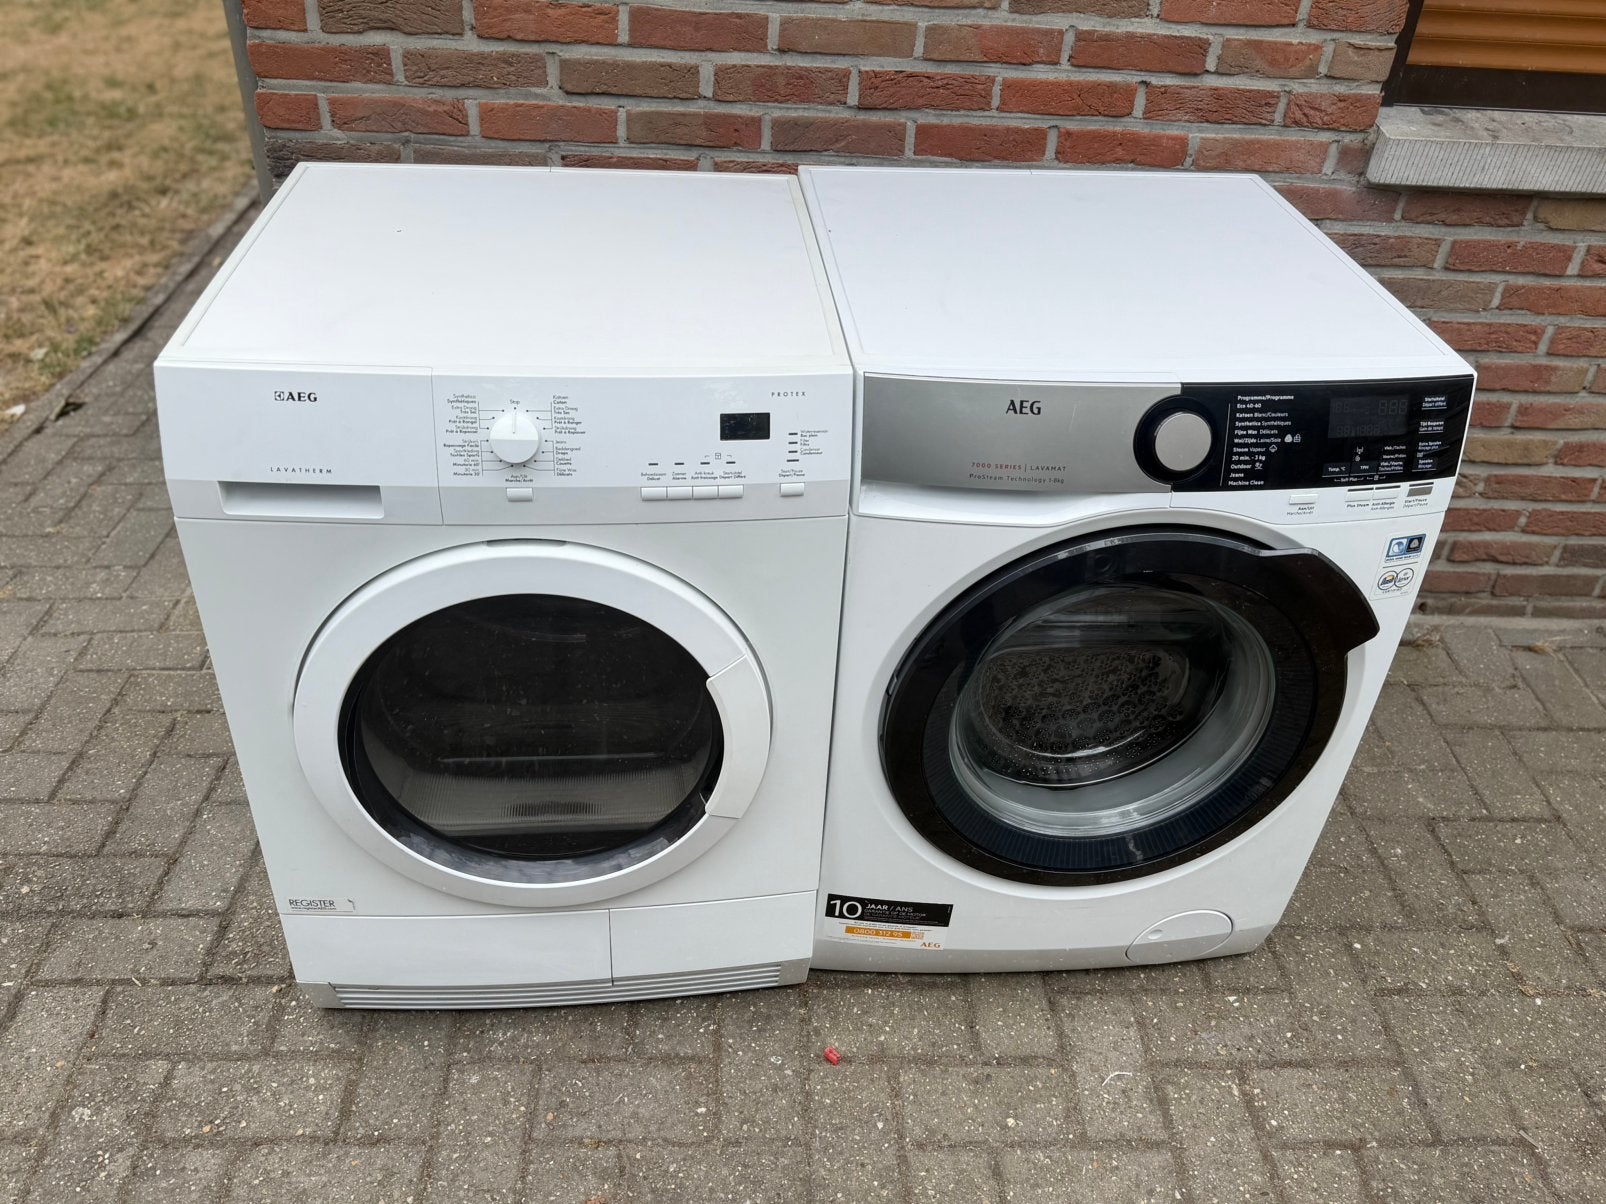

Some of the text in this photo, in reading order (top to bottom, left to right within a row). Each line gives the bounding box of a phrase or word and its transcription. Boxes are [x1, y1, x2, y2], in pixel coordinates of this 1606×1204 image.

[286, 391, 318, 402] AEG
[1005, 399, 1042, 416] AEG
[270, 466, 332, 474] LAVATHERM
[995, 463, 1022, 471] SERIES
[969, 473, 1004, 481] ProSteam
[1007, 474, 1047, 484] Technology
[289, 899, 336, 907] REGISTER
[865, 903, 889, 911] JAAR
[894, 905, 914, 913] ANS
[830, 899, 863, 918] 10
[853, 928, 876, 936] 0800
